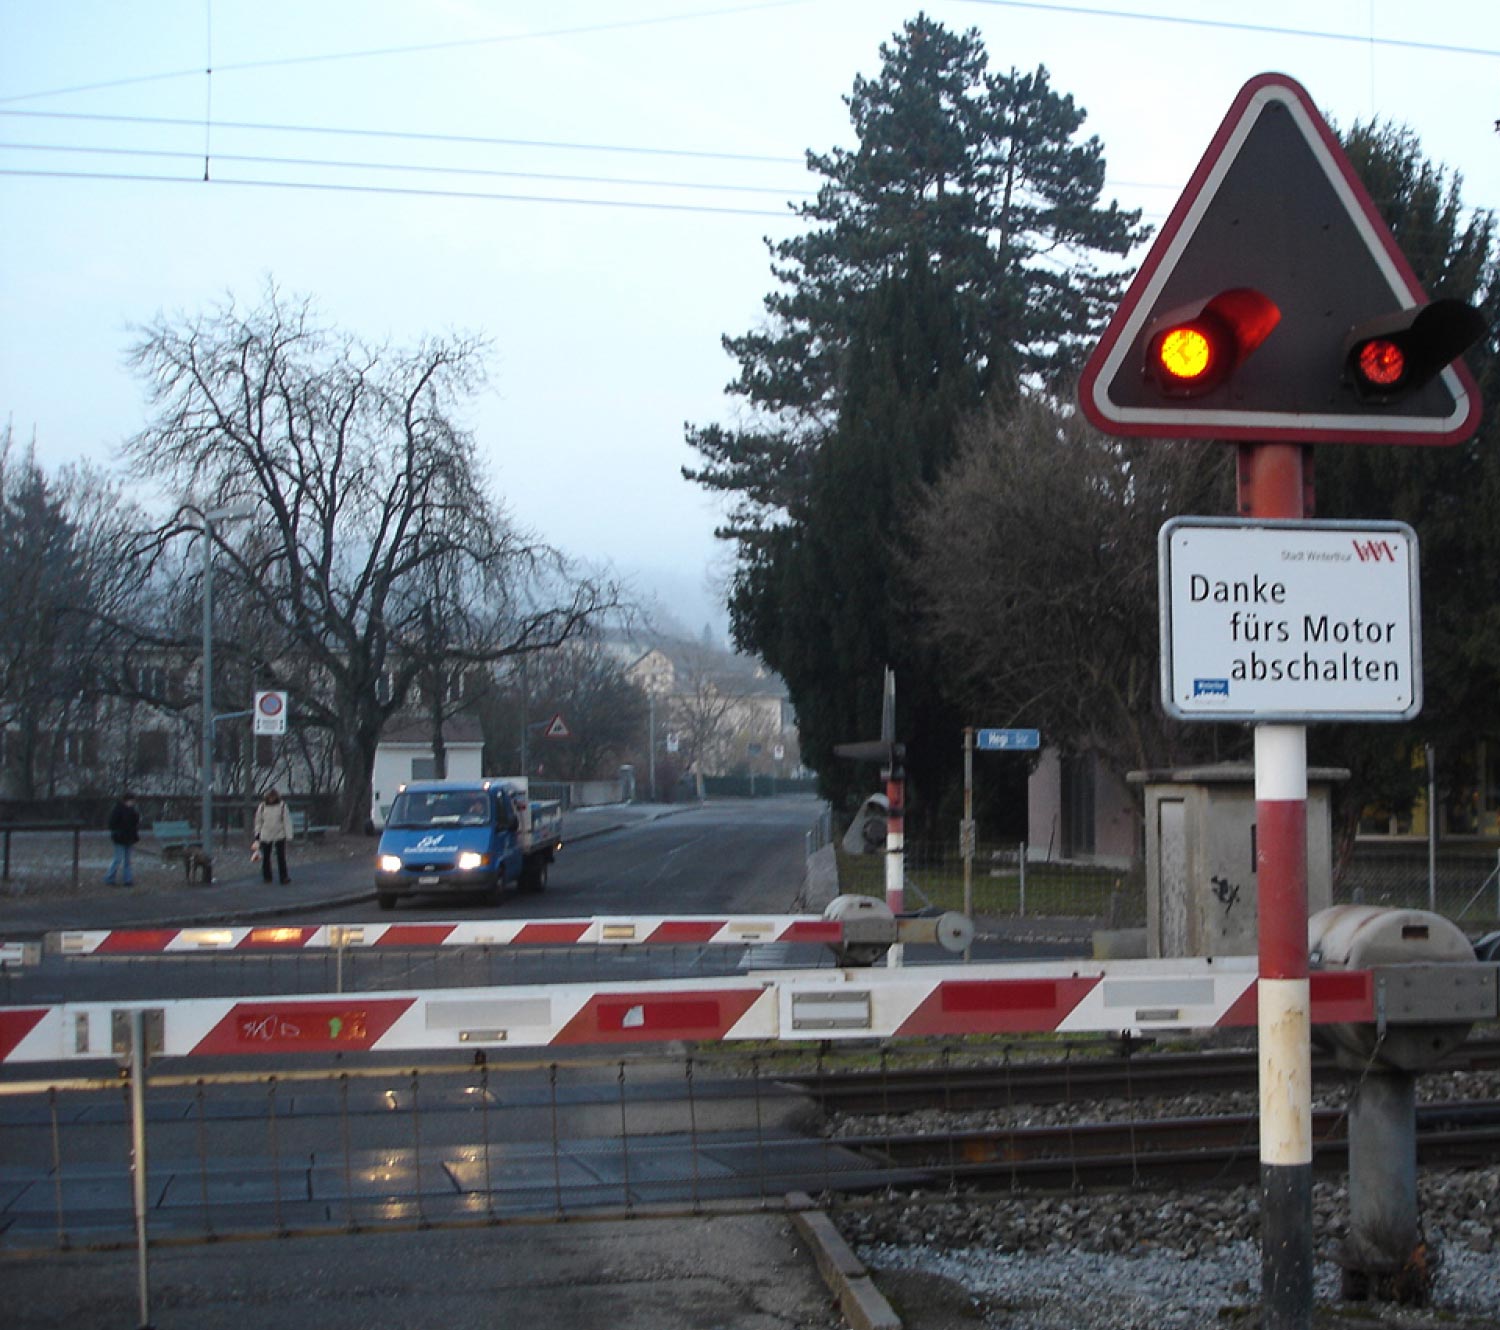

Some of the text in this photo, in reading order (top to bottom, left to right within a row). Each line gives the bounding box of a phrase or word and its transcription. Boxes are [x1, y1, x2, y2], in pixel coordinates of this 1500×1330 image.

[1190, 574, 1287, 603] Danke
[1230, 612, 1396, 643] fürs Motor
[1231, 652, 1399, 681] abschalten
